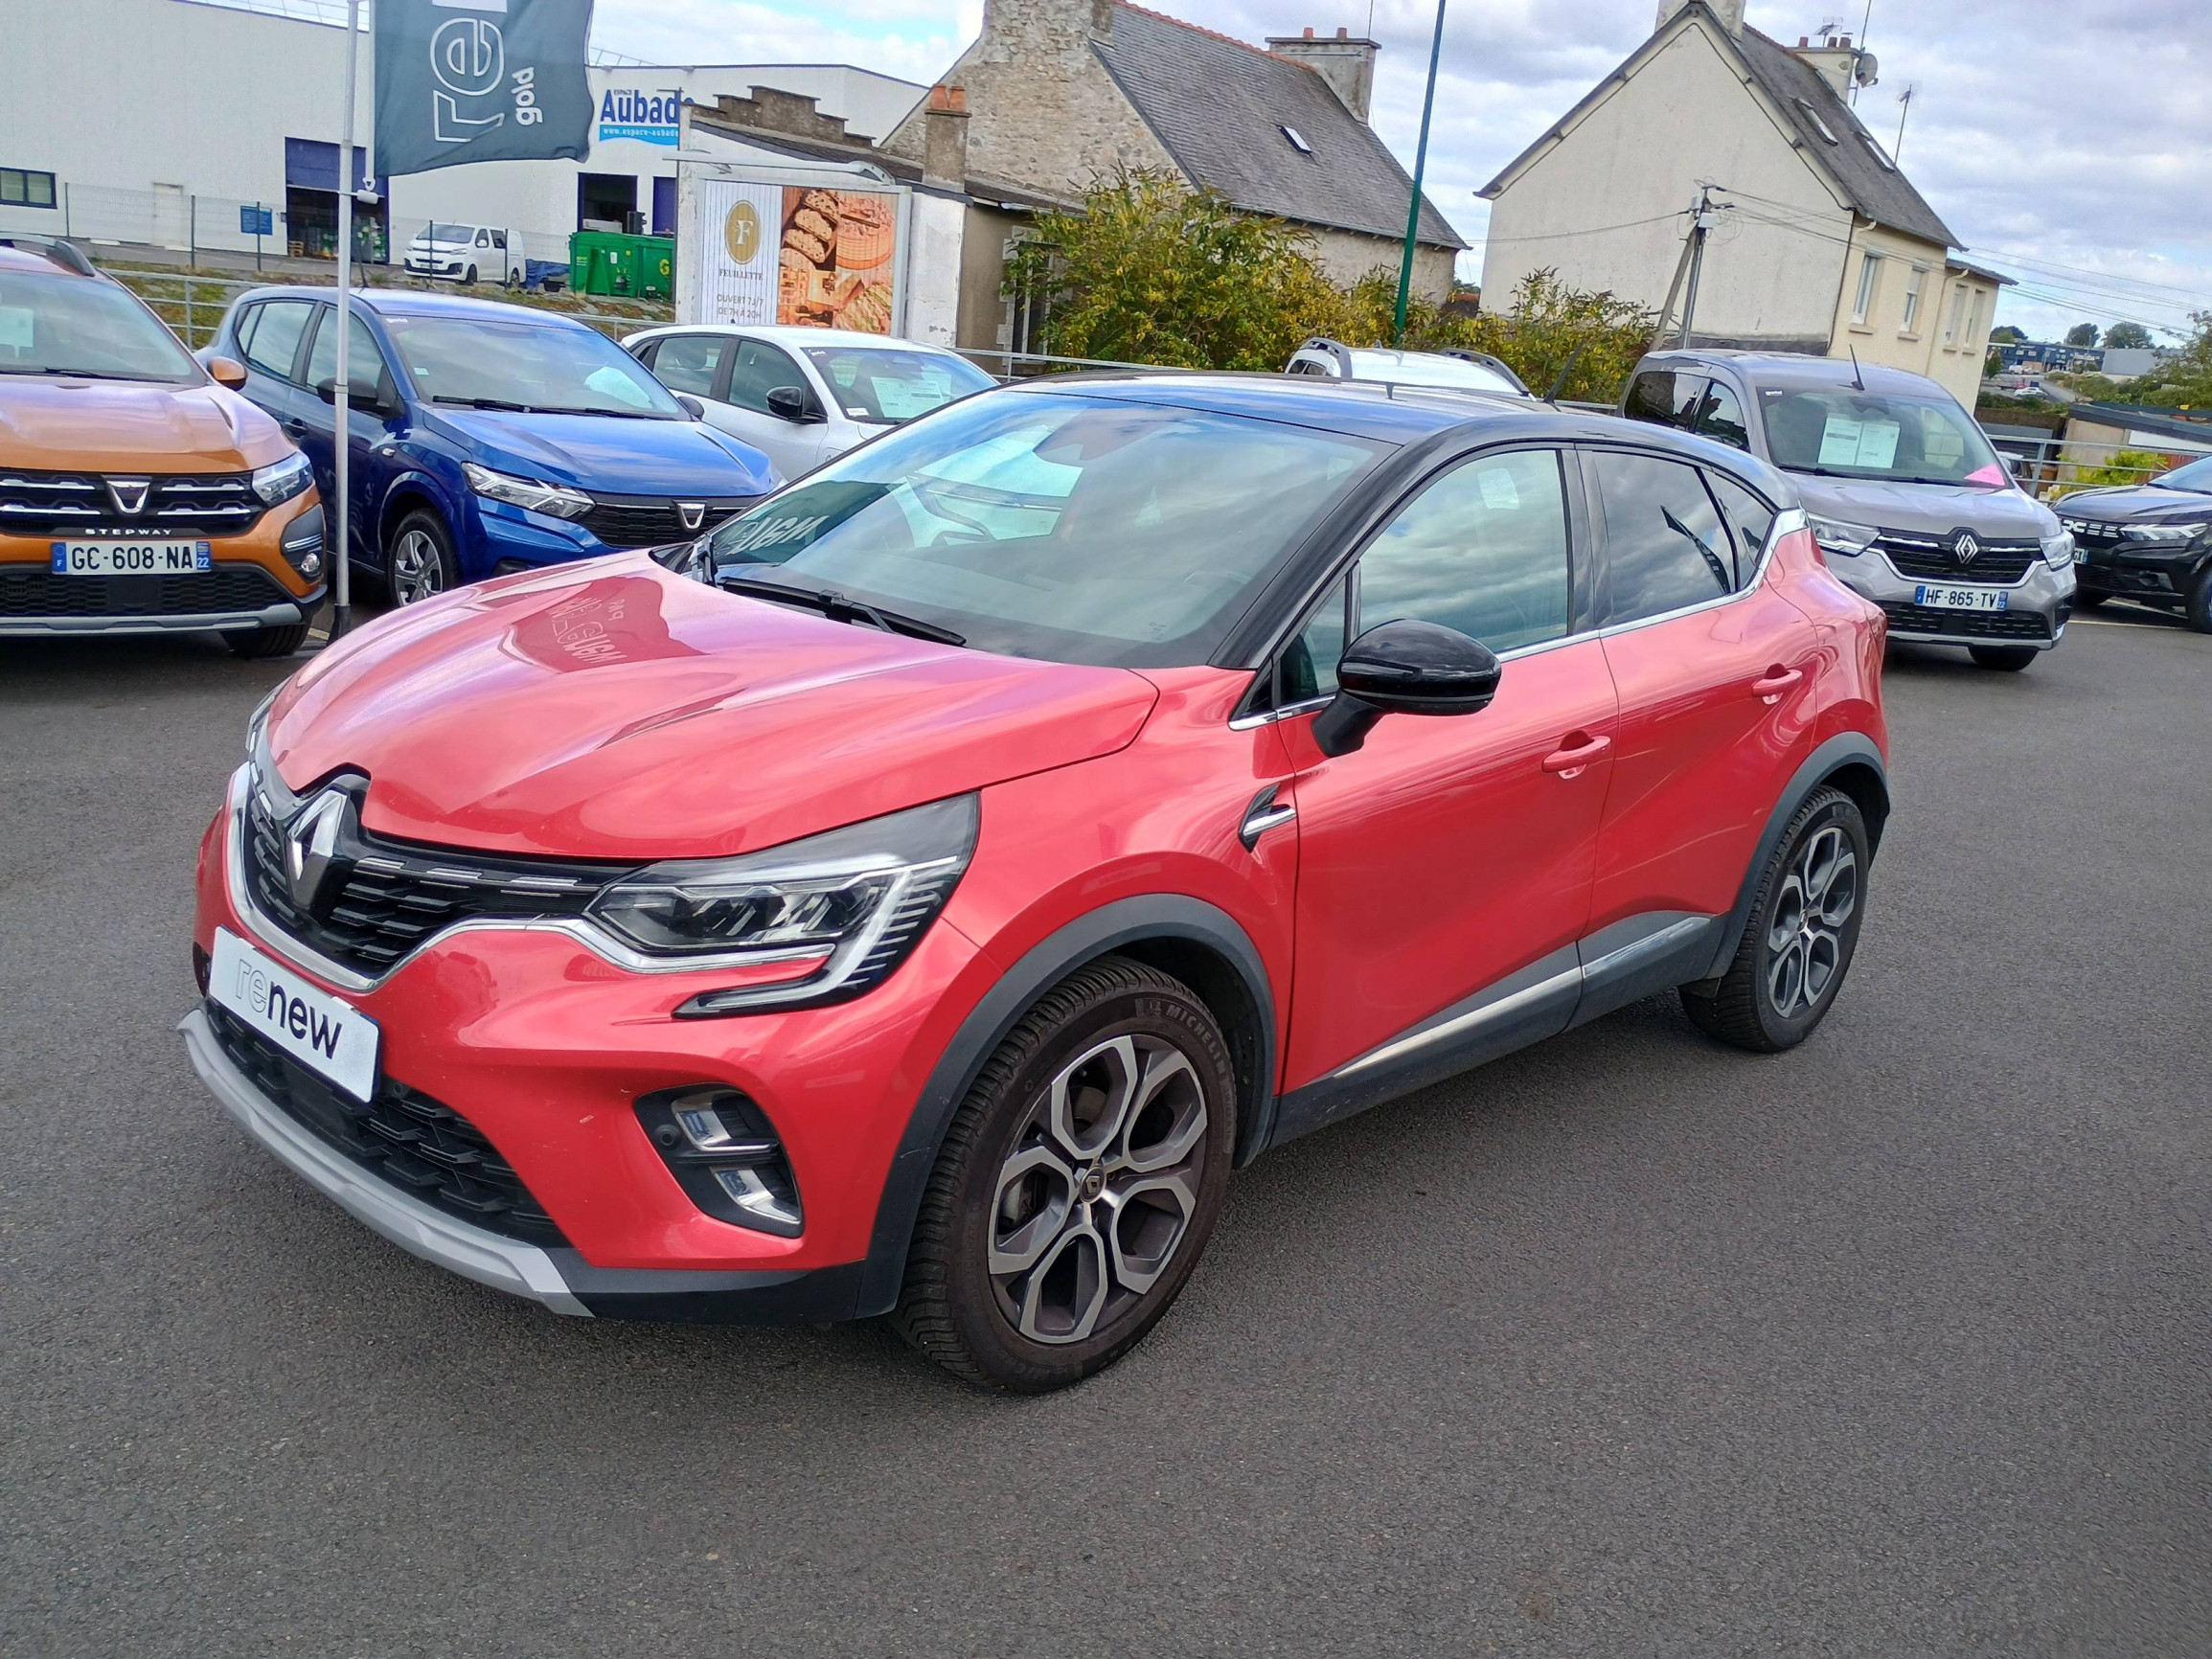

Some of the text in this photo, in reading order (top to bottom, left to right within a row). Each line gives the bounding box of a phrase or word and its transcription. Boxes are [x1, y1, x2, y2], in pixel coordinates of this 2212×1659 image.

[430, 0, 508, 143] re
[511, 66, 543, 125] gold
[600, 89, 695, 125] Aubad
[718, 268, 764, 281] FEUILLETTE
[717, 293, 764, 307] OUVERT 7J/7
[718, 307, 728, 315] DE
[729, 307, 739, 317] 7H
[746, 309, 762, 319] 20H
[71, 546, 194, 570] GC-608-NA
[196, 557, 210, 568] 22
[1926, 589, 1997, 608] HF-865-TV
[1996, 601, 2006, 609] 22
[236, 958, 343, 1060] renew
[1165, 1003, 1227, 1077] MICHELIN
